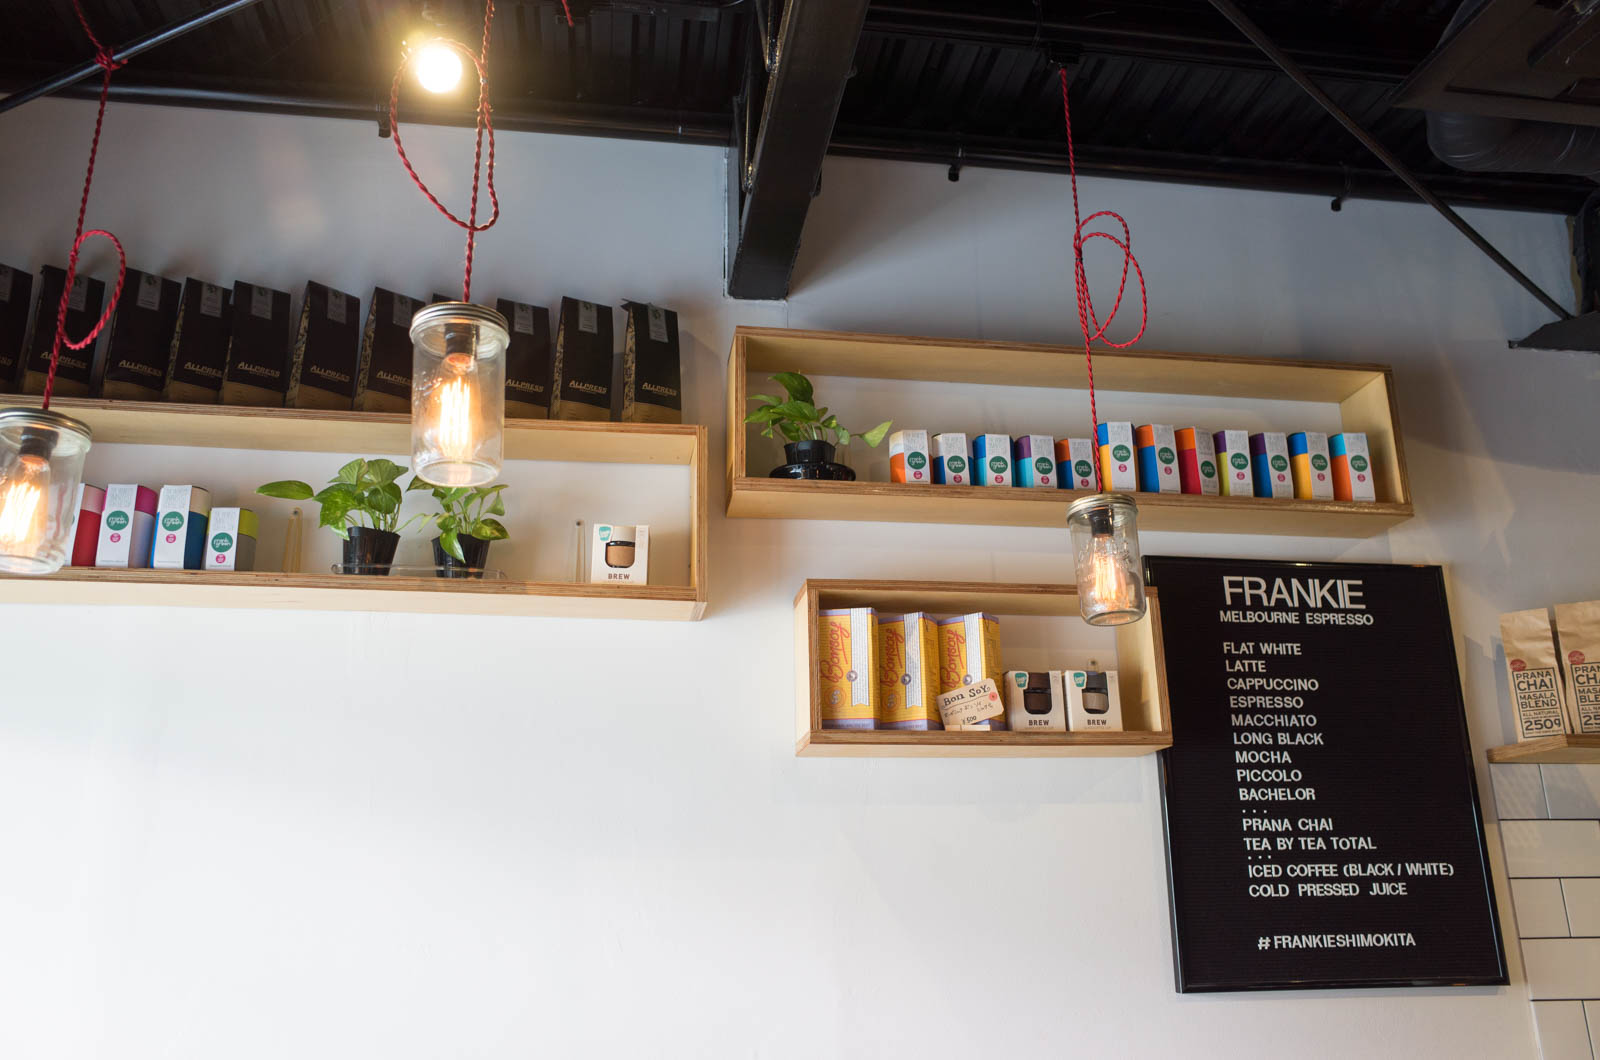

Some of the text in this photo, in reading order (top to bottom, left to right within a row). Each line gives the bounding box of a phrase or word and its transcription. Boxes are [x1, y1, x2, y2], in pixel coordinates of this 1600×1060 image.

[119, 359, 162, 376] ALLPRESS
[237, 362, 281, 377] ALLPRESS
[310, 365, 350, 382] ALLPRESS
[505, 378, 544, 392] ALLPRESS
[569, 380, 607, 394] ALLPRESS
[642, 382, 677, 396] ALLPRESS
[1223, 576, 1366, 609] FRANKIE
[1220, 611, 1373, 625] MELBOURNE ESPRESSO
[1224, 642, 1301, 655] FLAT WHITE
[1226, 660, 1266, 672] LATTE
[1516, 671, 1552, 680] PRANA
[1228, 678, 1318, 690] CAPPUCCINO
[1517, 678, 1554, 691] CHAI
[1230, 696, 1303, 708] ESPRESSO
[1520, 692, 1556, 701] MASALA
[1521, 699, 1557, 709] BLEND
[1232, 715, 1316, 726] MACCHIATO
[1524, 719, 1562, 731] 250g
[1234, 733, 1323, 745] LONG BLACK
[1236, 751, 1291, 763] MOCHA
[1237, 769, 1302, 782] PICCOLO
[1239, 788, 1315, 800] BACHELOR
[1243, 818, 1333, 831] PRANA CHAI
[1243, 837, 1377, 850] TEA BY TEA TOTAL
[1248, 865, 1282, 878] ICED
[1287, 864, 1338, 877] COFFEE
[1343, 863, 1394, 877] (BLACK
[1405, 863, 1454, 876] WHITE)
[1249, 883, 1407, 897] COLD PRESSED JUICE
